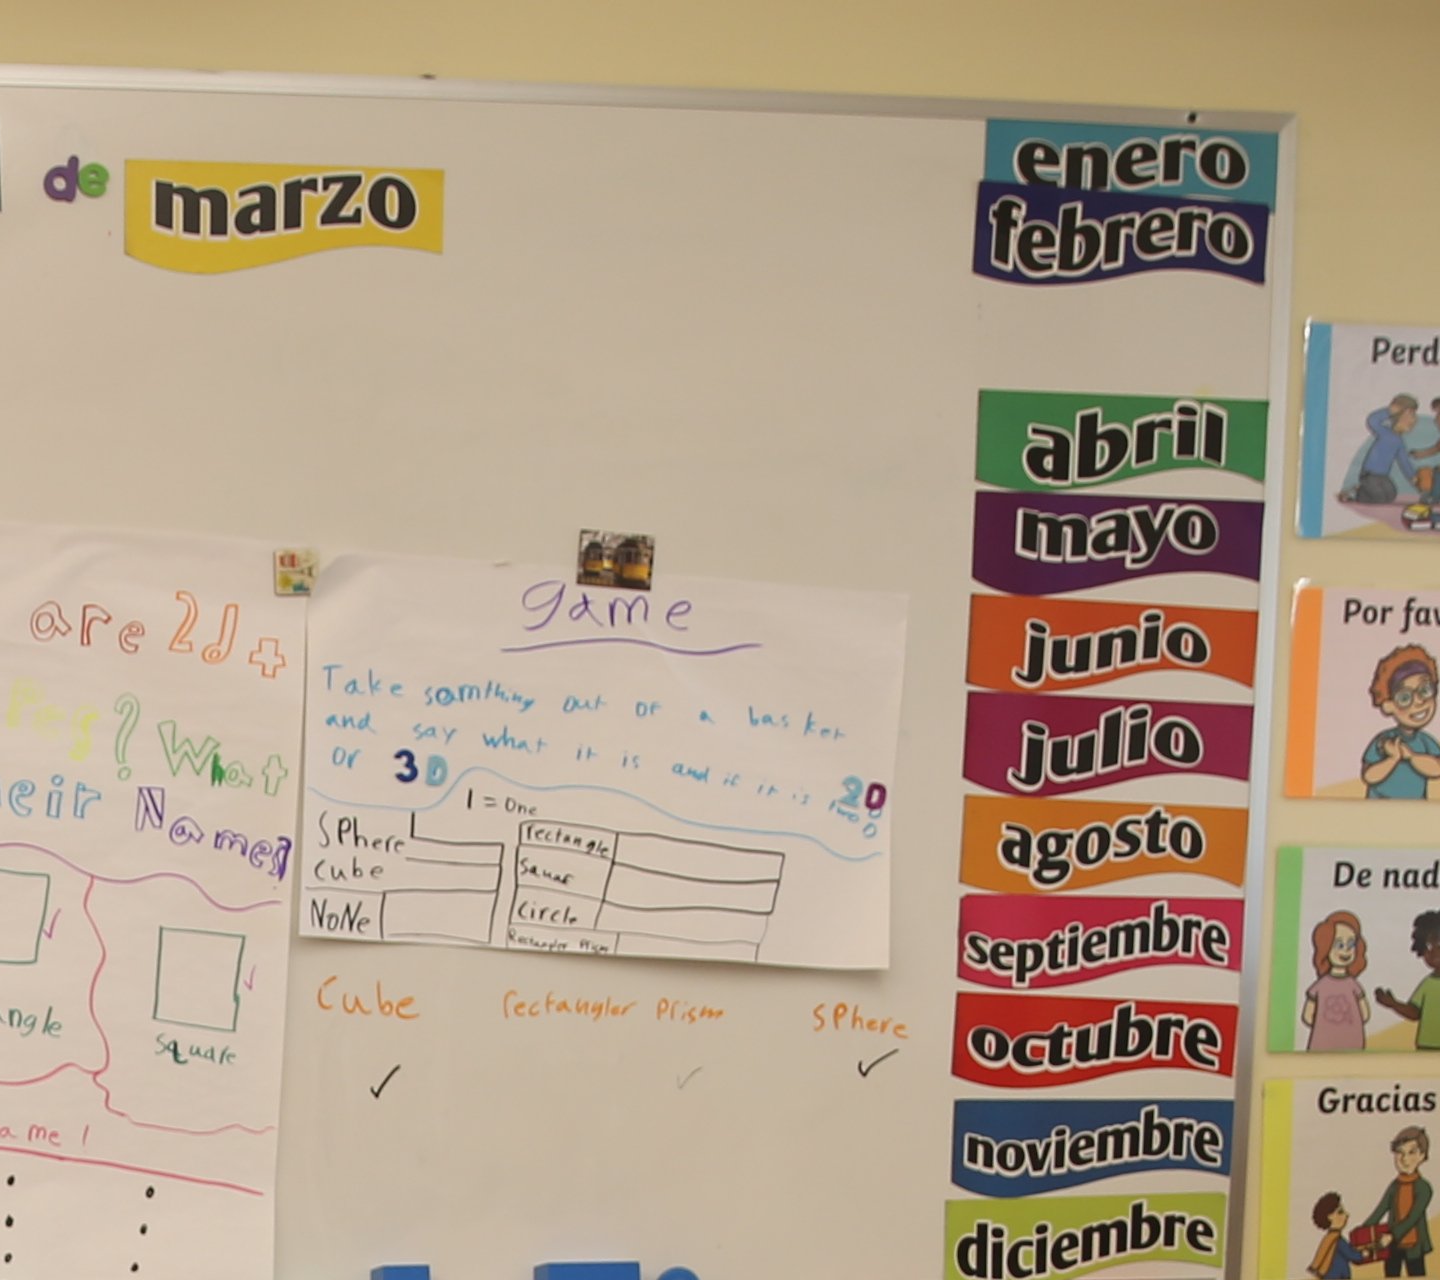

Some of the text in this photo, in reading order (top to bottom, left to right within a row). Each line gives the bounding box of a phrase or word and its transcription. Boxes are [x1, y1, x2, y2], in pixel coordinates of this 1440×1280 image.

[1012, 133, 1250, 190] enero
[43, 155, 111, 203] de
[150, 170, 418, 240] marzo
[988, 196, 1256, 277] febrero
[1021, 400, 1230, 487] abril
[1014, 503, 1219, 569] mayo
[29, 600, 146, 655] are
[1342, 597, 1393, 626] Por
[321, 663, 405, 698] Take
[1011, 610, 1211, 687] junio
[1006, 703, 1203, 792] julio
[998, 806, 1205, 888] agosto
[1332, 860, 1372, 889] De
[963, 900, 1231, 988] septiembre
[968, 1003, 1224, 1072] octubre
[1317, 1086, 1437, 1115] Gracias
[963, 1106, 1225, 1178] noviembre
